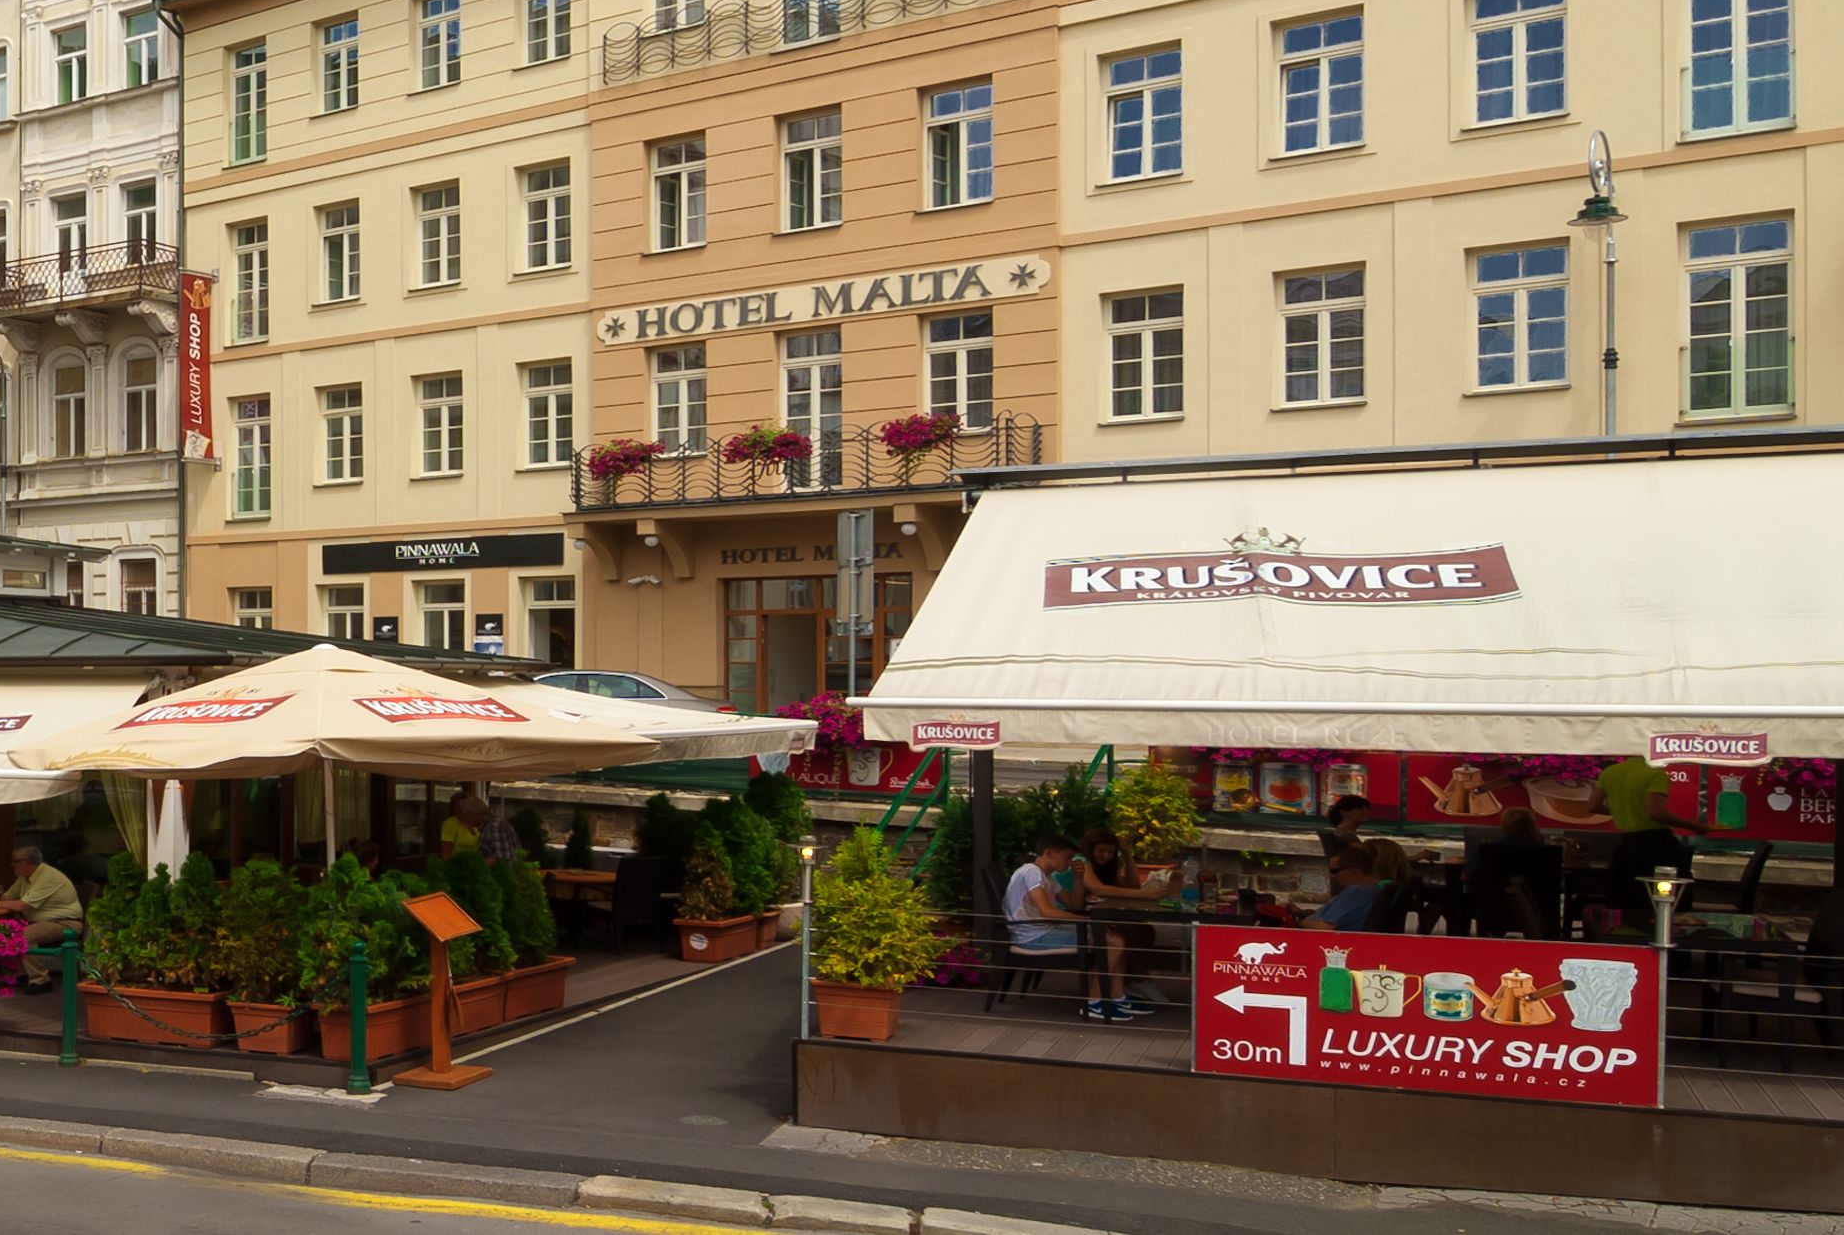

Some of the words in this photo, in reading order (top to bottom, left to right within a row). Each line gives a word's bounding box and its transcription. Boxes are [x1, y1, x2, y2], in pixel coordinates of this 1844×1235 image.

[635, 294, 792, 340] HOTEL
[812, 264, 992, 318] MALTA
[189, 312, 202, 361] SHOP
[189, 362, 202, 425] LUXURY
[395, 541, 480, 558] PINNAWALA
[720, 545, 804, 565] HOTEL
[812, 541, 904, 562] MTA
[418, 557, 456, 565] HOME
[1070, 557, 1483, 595] KRUŠOVICE
[1136, 585, 1283, 601] KRÁLOVSKÝ
[1292, 589, 1412, 601] PIVOVAR
[134, 701, 274, 723] KRUŠOVICE
[362, 698, 517, 719] KRUŠOVICE
[917, 723, 996, 741] KRUŠOVICE
[1207, 724, 1309, 744] HOTEL
[1655, 736, 1760, 755] KRUŠOVICE
[1212, 962, 1307, 979] PINNAWALA
[1240, 975, 1281, 984] HOME
[1212, 1038, 1282, 1064] 30m
[1320, 1028, 1494, 1065] LUXURY
[1502, 1040, 1638, 1075] SHOP
[1319, 1060, 1587, 1088] www.pinnawala.cz
